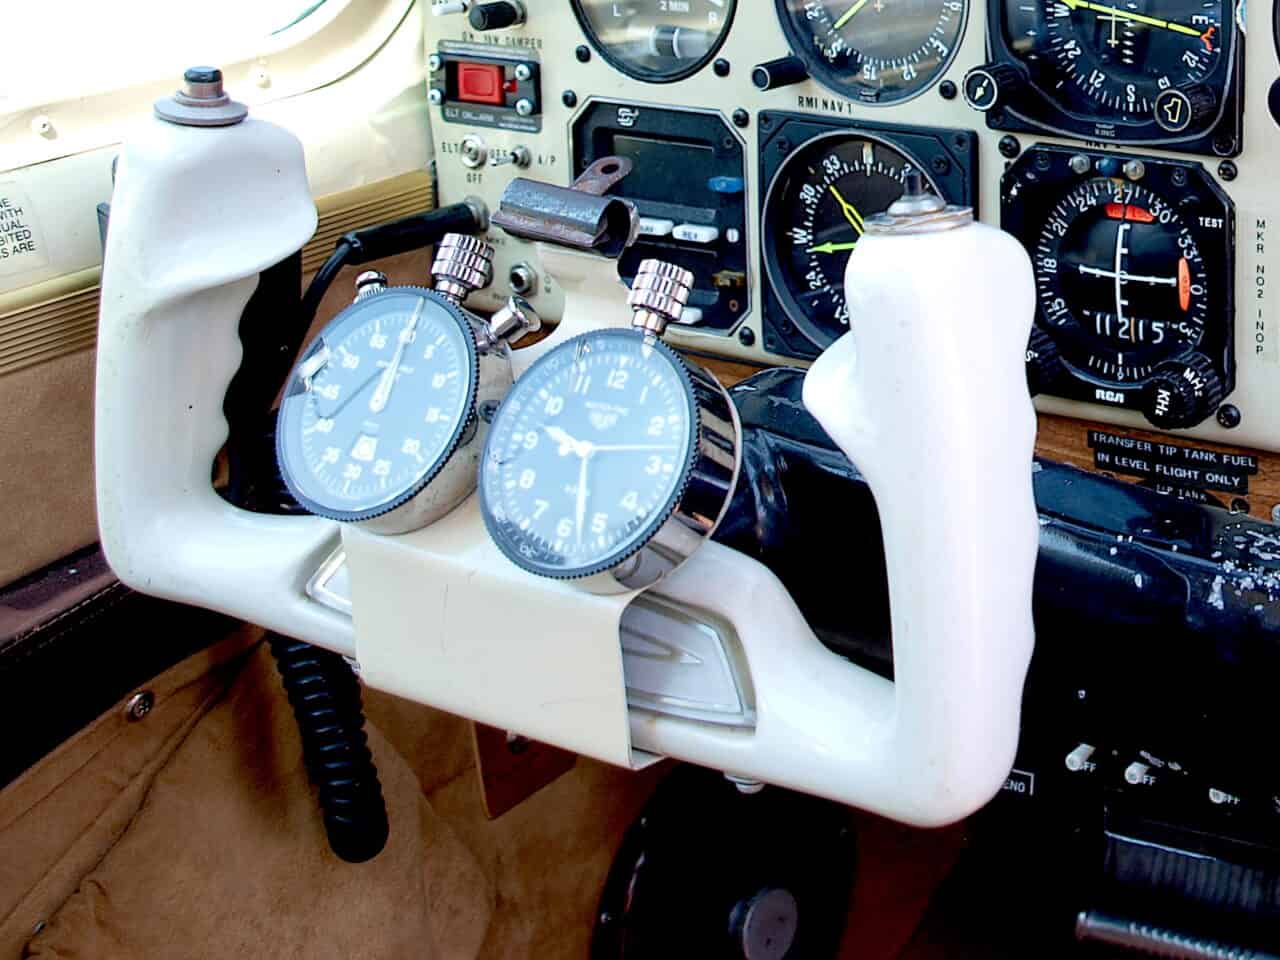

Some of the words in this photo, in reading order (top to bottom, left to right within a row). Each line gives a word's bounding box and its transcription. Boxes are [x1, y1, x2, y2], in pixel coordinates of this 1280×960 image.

[798, 95, 818, 109] RMI
[821, 98, 844, 111] NAV
[1199, 216, 1223, 229] TEST
[13, 241, 36, 255] ARE
[608, 370, 627, 389] 12
[545, 396, 563, 416] 10
[1093, 432, 1152, 452] TRANSFER
[1159, 445, 1177, 456] TIP
[1184, 448, 1217, 463] TANK
[1223, 456, 1256, 467] FUEL
[1098, 452, 1110, 463] IN
[1115, 457, 1150, 472] LEVEL
[1156, 464, 1200, 480] FLIGHT
[1206, 473, 1240, 487] ONLY
[533, 500, 549, 519] 7
